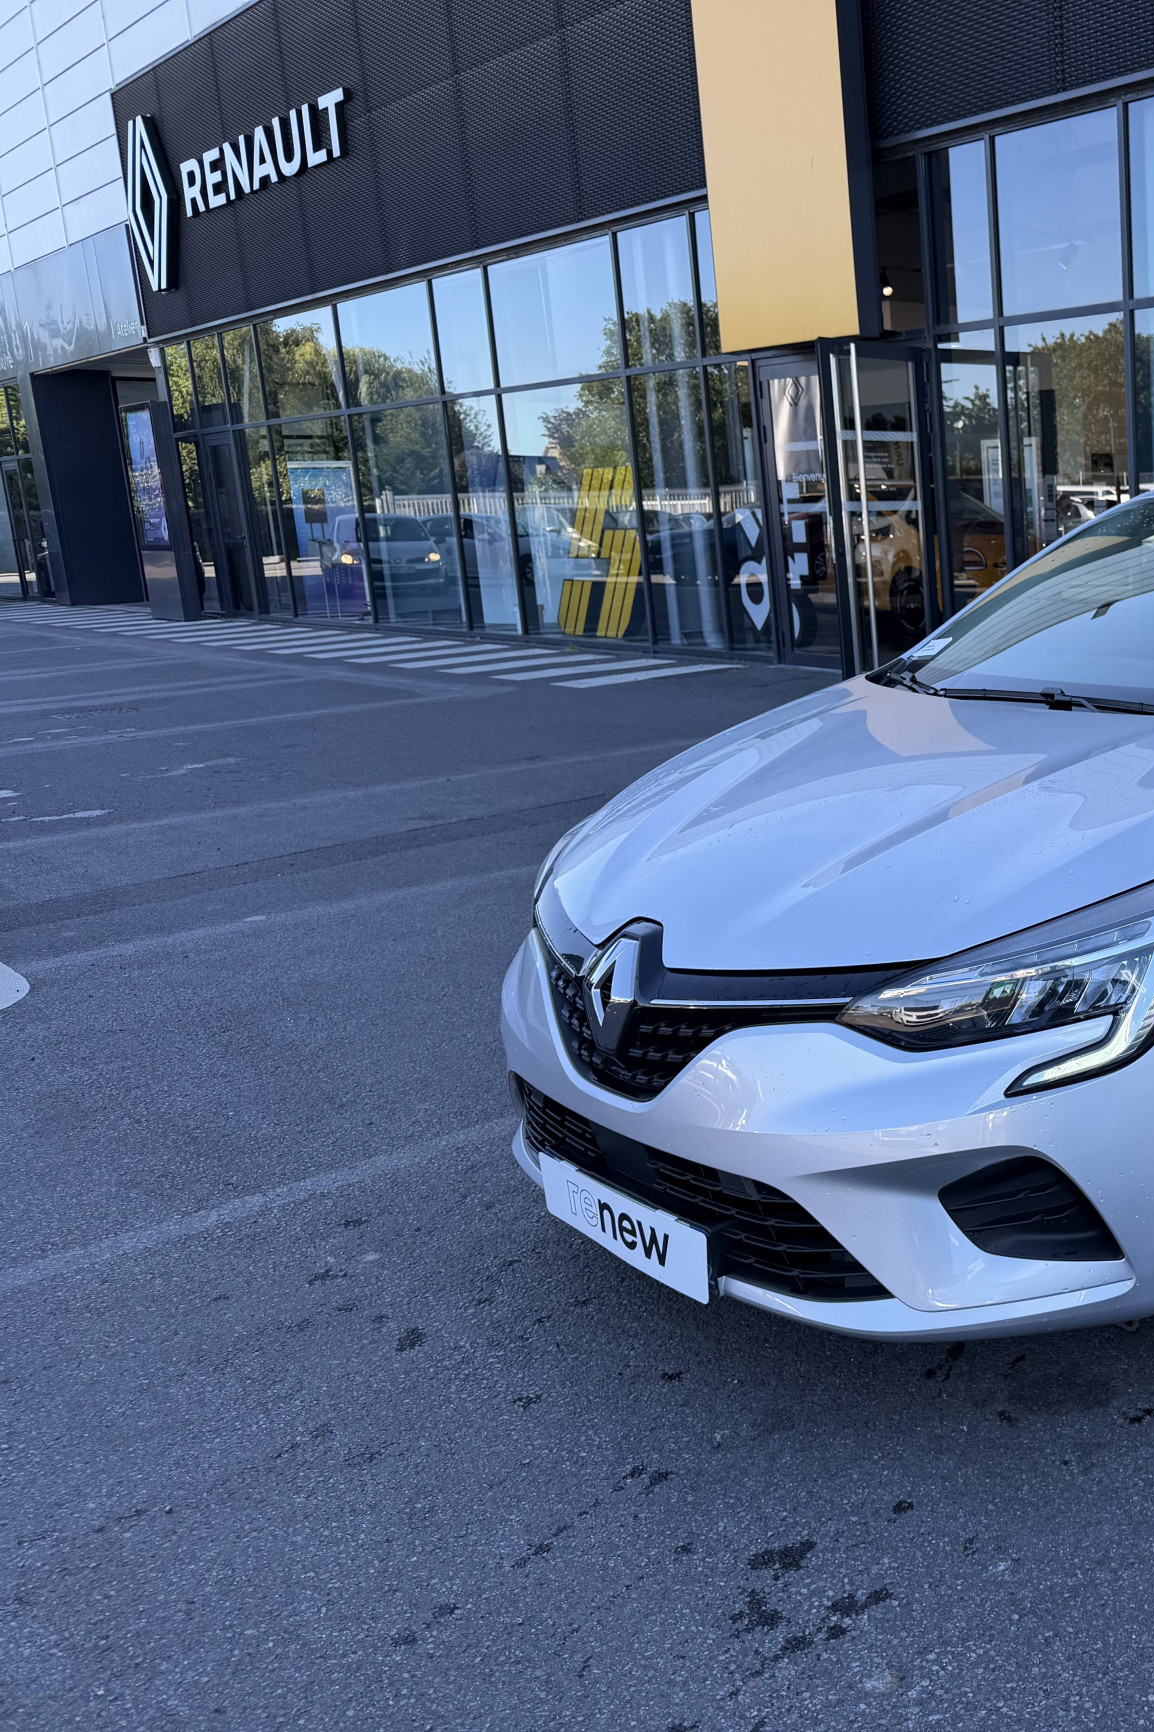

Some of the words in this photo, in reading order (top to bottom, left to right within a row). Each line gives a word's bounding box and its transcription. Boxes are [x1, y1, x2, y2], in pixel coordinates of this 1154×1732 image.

[179, 87, 345, 218] RENAULT
[117, 319, 138, 338] Atelier
[792, 471, 826, 482] Bienvenu
[566, 1179, 670, 1268] renew
